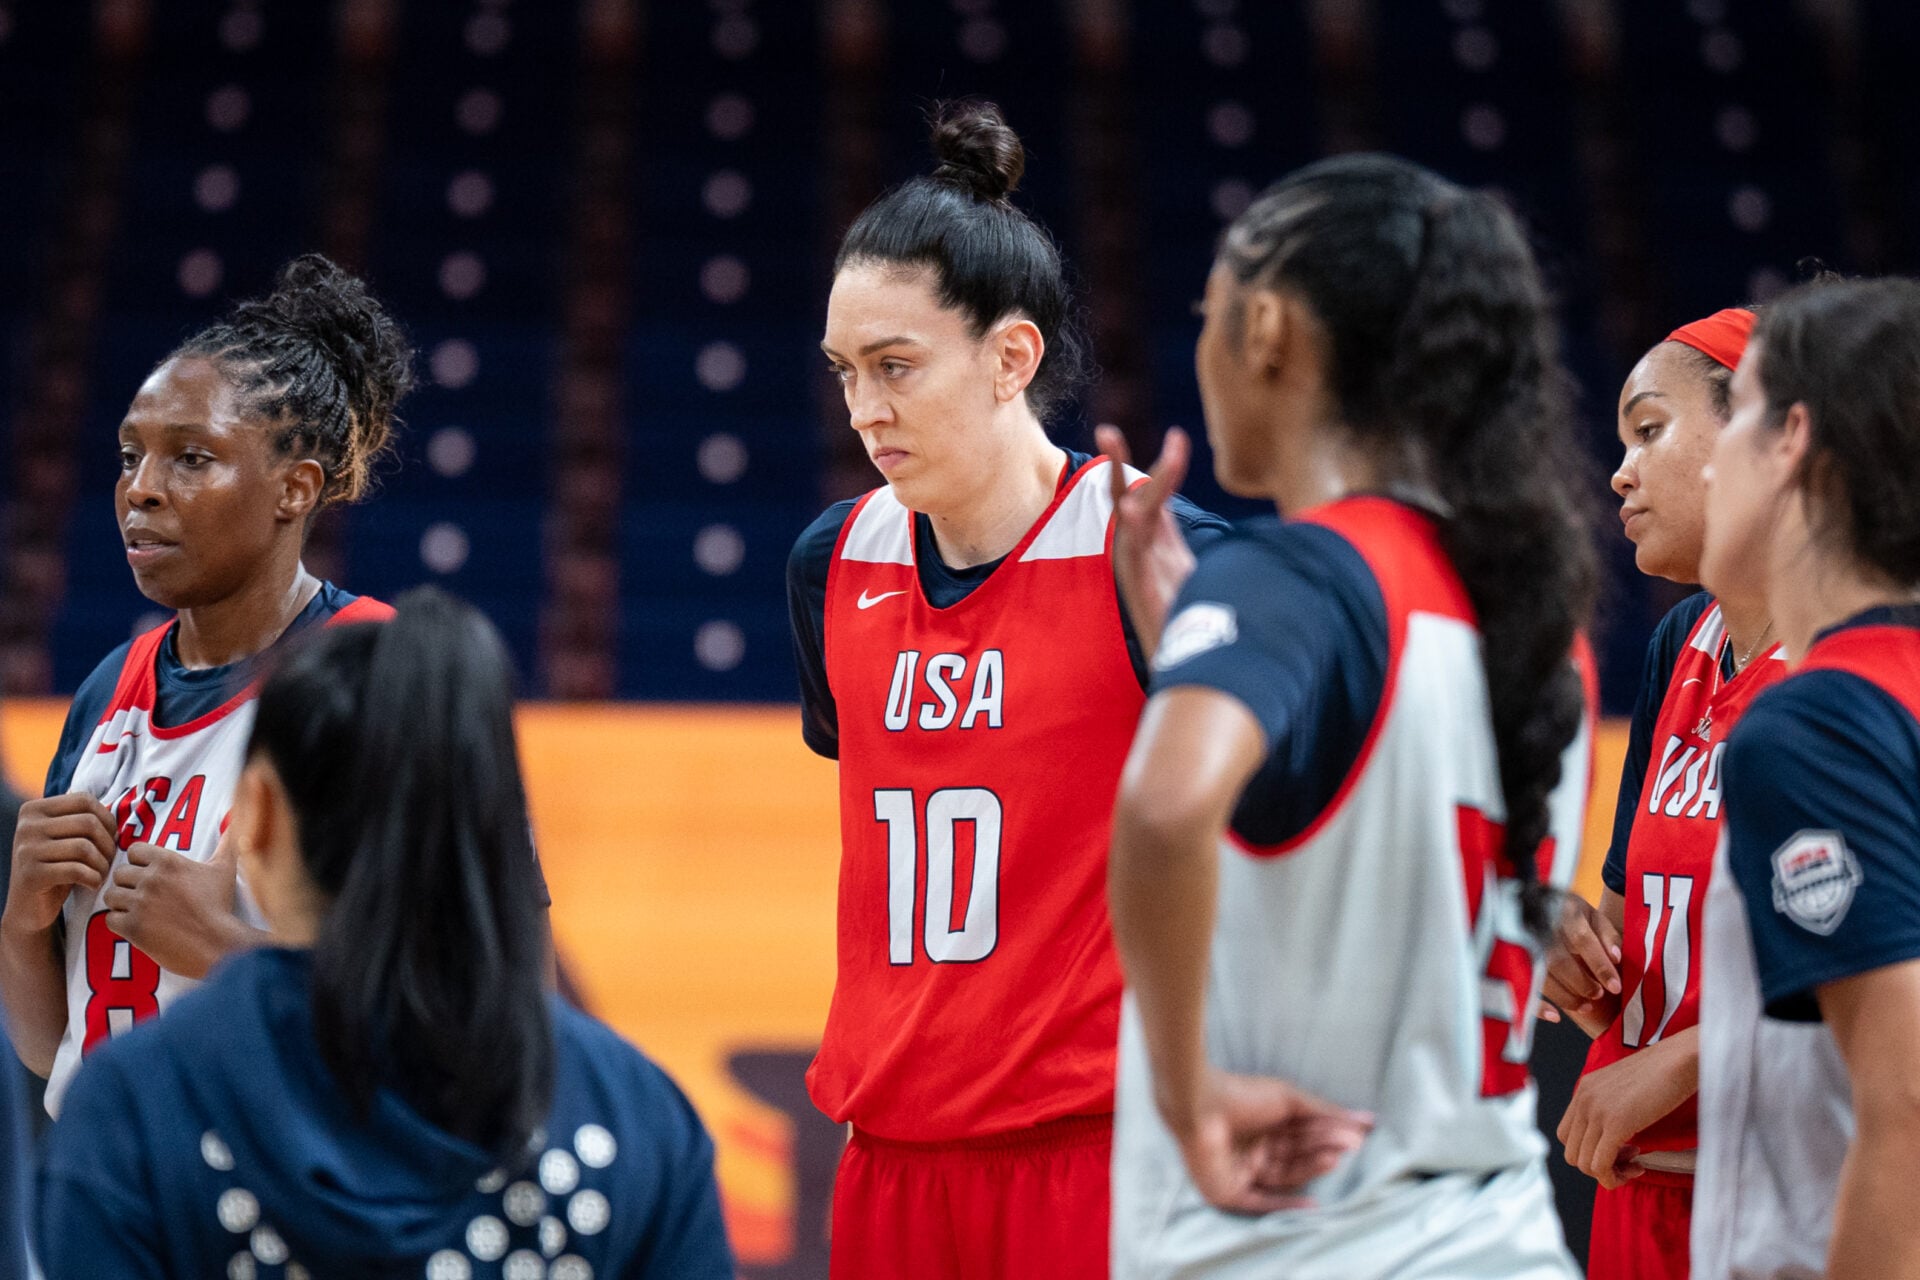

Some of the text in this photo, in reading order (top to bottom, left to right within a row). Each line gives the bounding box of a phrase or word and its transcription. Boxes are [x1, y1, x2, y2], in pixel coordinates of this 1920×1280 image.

[884, 649, 1003, 730] USA
[1648, 733, 1726, 819] USA
[874, 787, 1003, 966] 10
[1622, 873, 1694, 1047] 11
